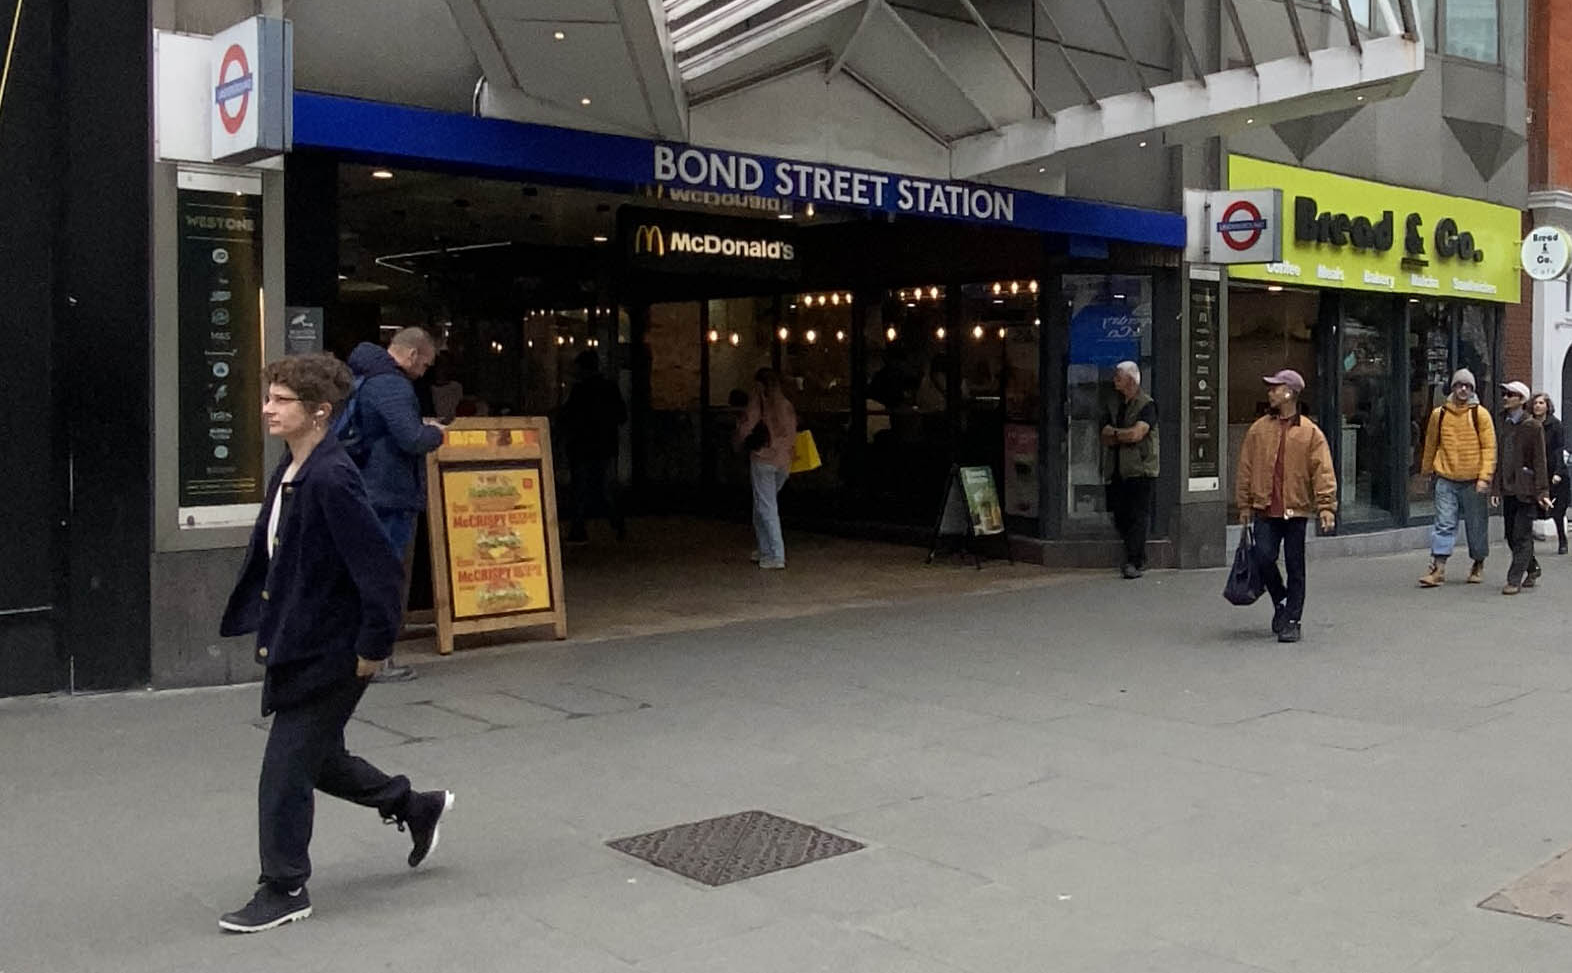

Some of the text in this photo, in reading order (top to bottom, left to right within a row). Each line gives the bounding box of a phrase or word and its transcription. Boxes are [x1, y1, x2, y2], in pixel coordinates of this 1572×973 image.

[653, 146, 1014, 221] BOND STREET STATION
[670, 231, 794, 260] McDonald's
[1295, 195, 1484, 263] Bread & Co.
[1533, 234, 1558, 242] Bread
